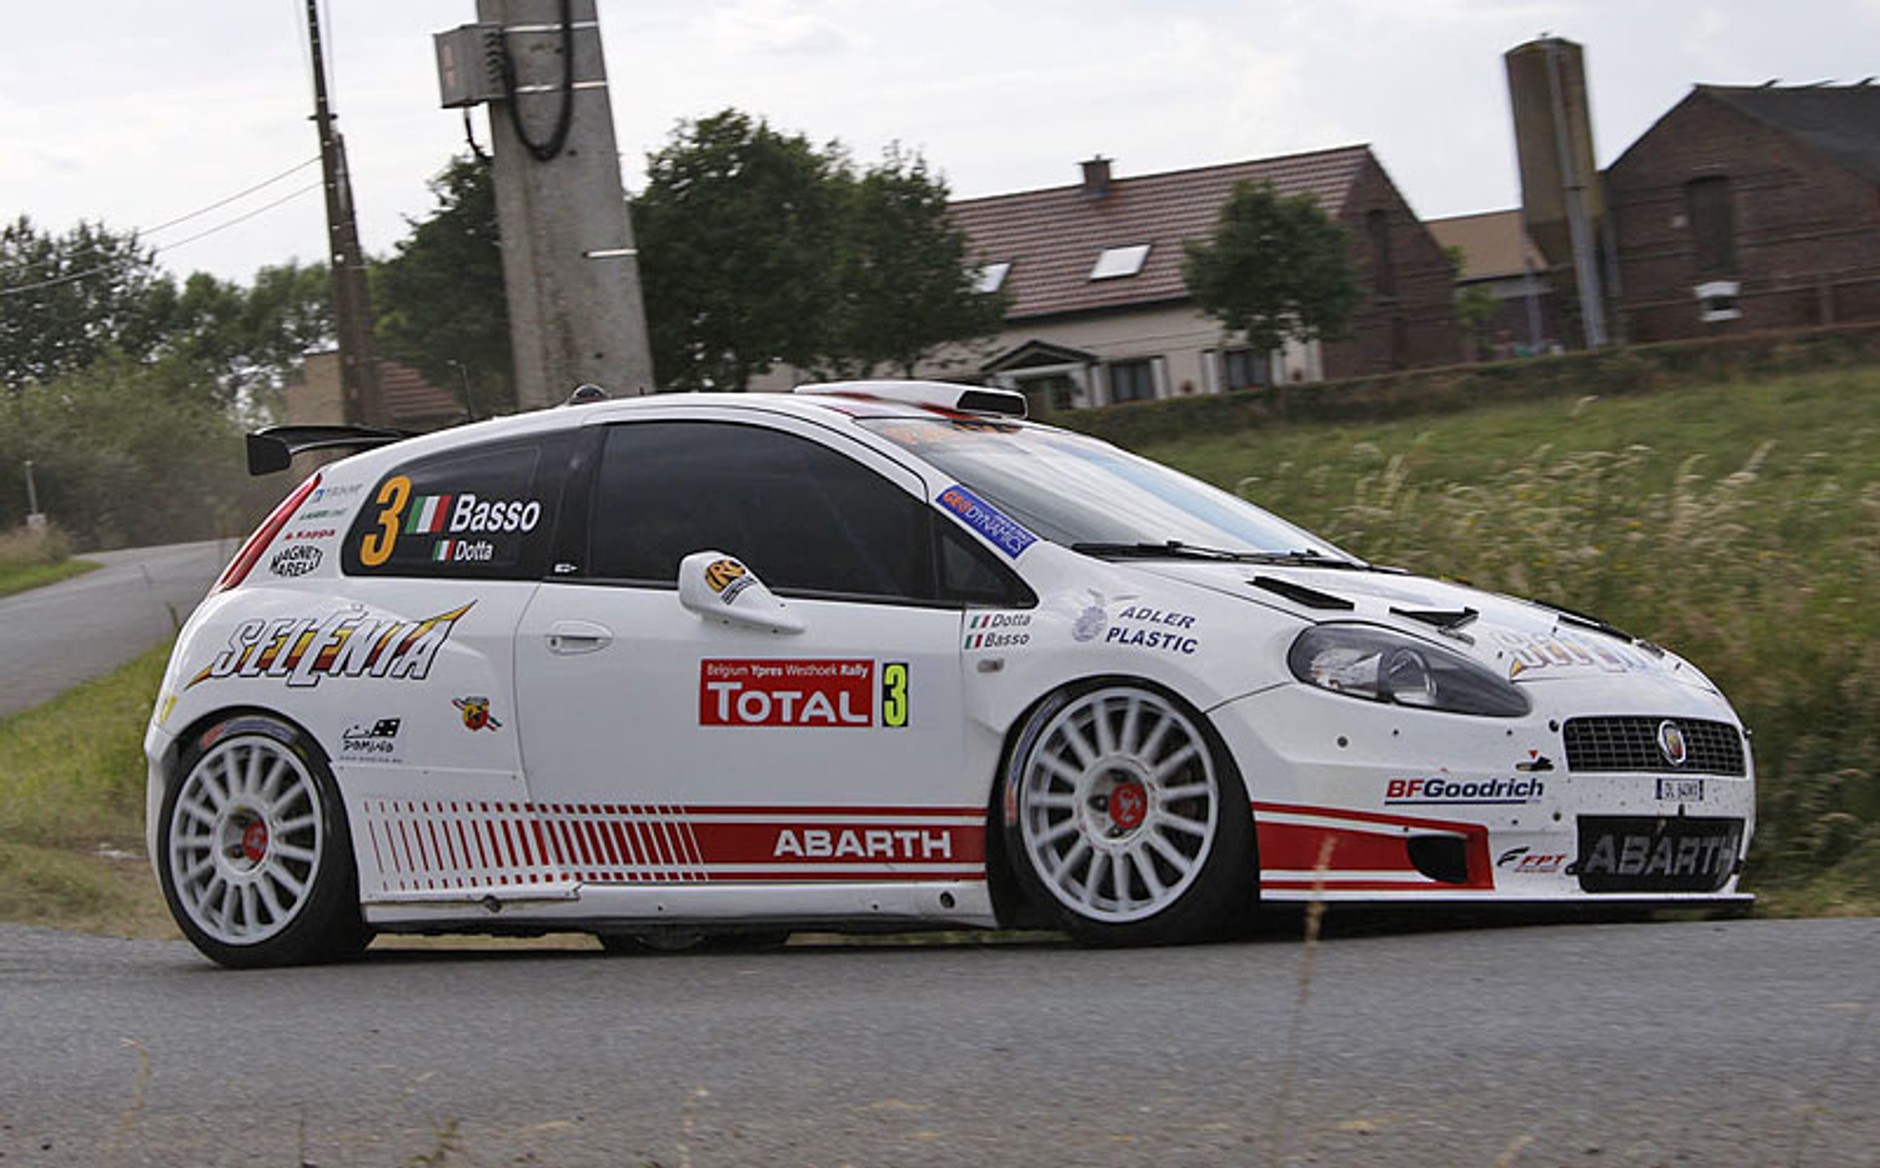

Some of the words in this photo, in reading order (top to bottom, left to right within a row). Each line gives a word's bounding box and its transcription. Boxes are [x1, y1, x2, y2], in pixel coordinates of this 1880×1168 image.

[360, 475, 412, 566] 3
[449, 493, 541, 533] Basso
[454, 540, 493, 561] Dotta
[991, 613, 1031, 628] Dotta
[1118, 606, 1196, 629] ADLER
[210, 604, 455, 687] SELENIA
[984, 633, 1030, 647] Basso
[1105, 627, 1198, 654] PLASTIC
[707, 664, 748, 678] Belgium
[751, 665, 783, 678] Ypres
[785, 664, 836, 676] Westhoek
[840, 664, 868, 679] Rally
[707, 682, 868, 723] TOTAL
[883, 664, 907, 727] 3
[1386, 778, 1544, 798] BFGoodrich
[773, 829, 952, 858] ABARTH
[1584, 834, 1740, 875] ABARTH
